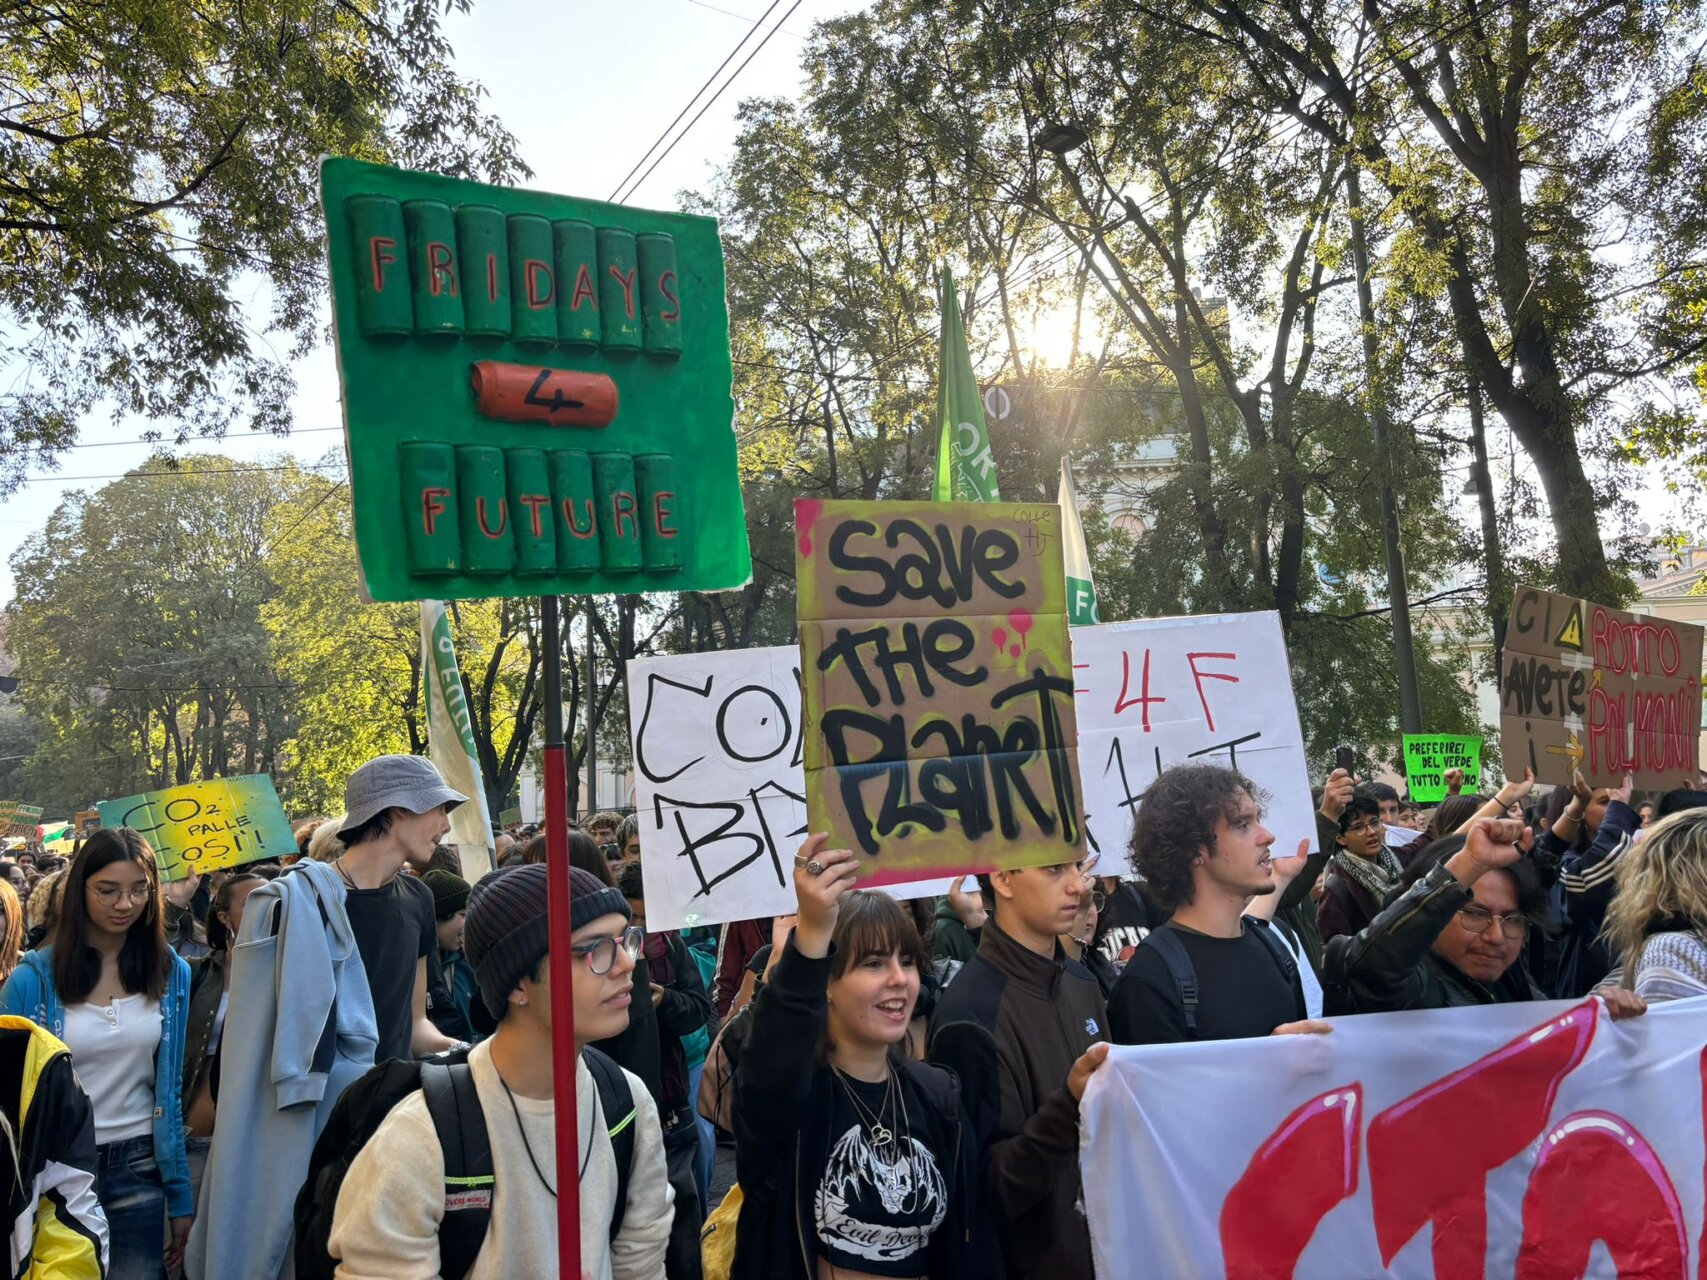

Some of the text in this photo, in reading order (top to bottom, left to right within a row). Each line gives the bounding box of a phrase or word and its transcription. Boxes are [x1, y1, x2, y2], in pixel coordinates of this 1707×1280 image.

[368, 236, 680, 321] FRIDAYS
[523, 368, 585, 413] 4
[422, 487, 680, 542] FUTURE
[1516, 591, 1550, 643] CI
[1591, 606, 1680, 676] ROTTO
[636, 666, 804, 784] CO
[1409, 742, 1466, 755] PREFERIREI
[1422, 756, 1473, 768] DEL VERDE
[1411, 774, 1440, 787] TUTTO
[188, 815, 252, 836] PALLE
[836, 1218, 882, 1247] Evil
